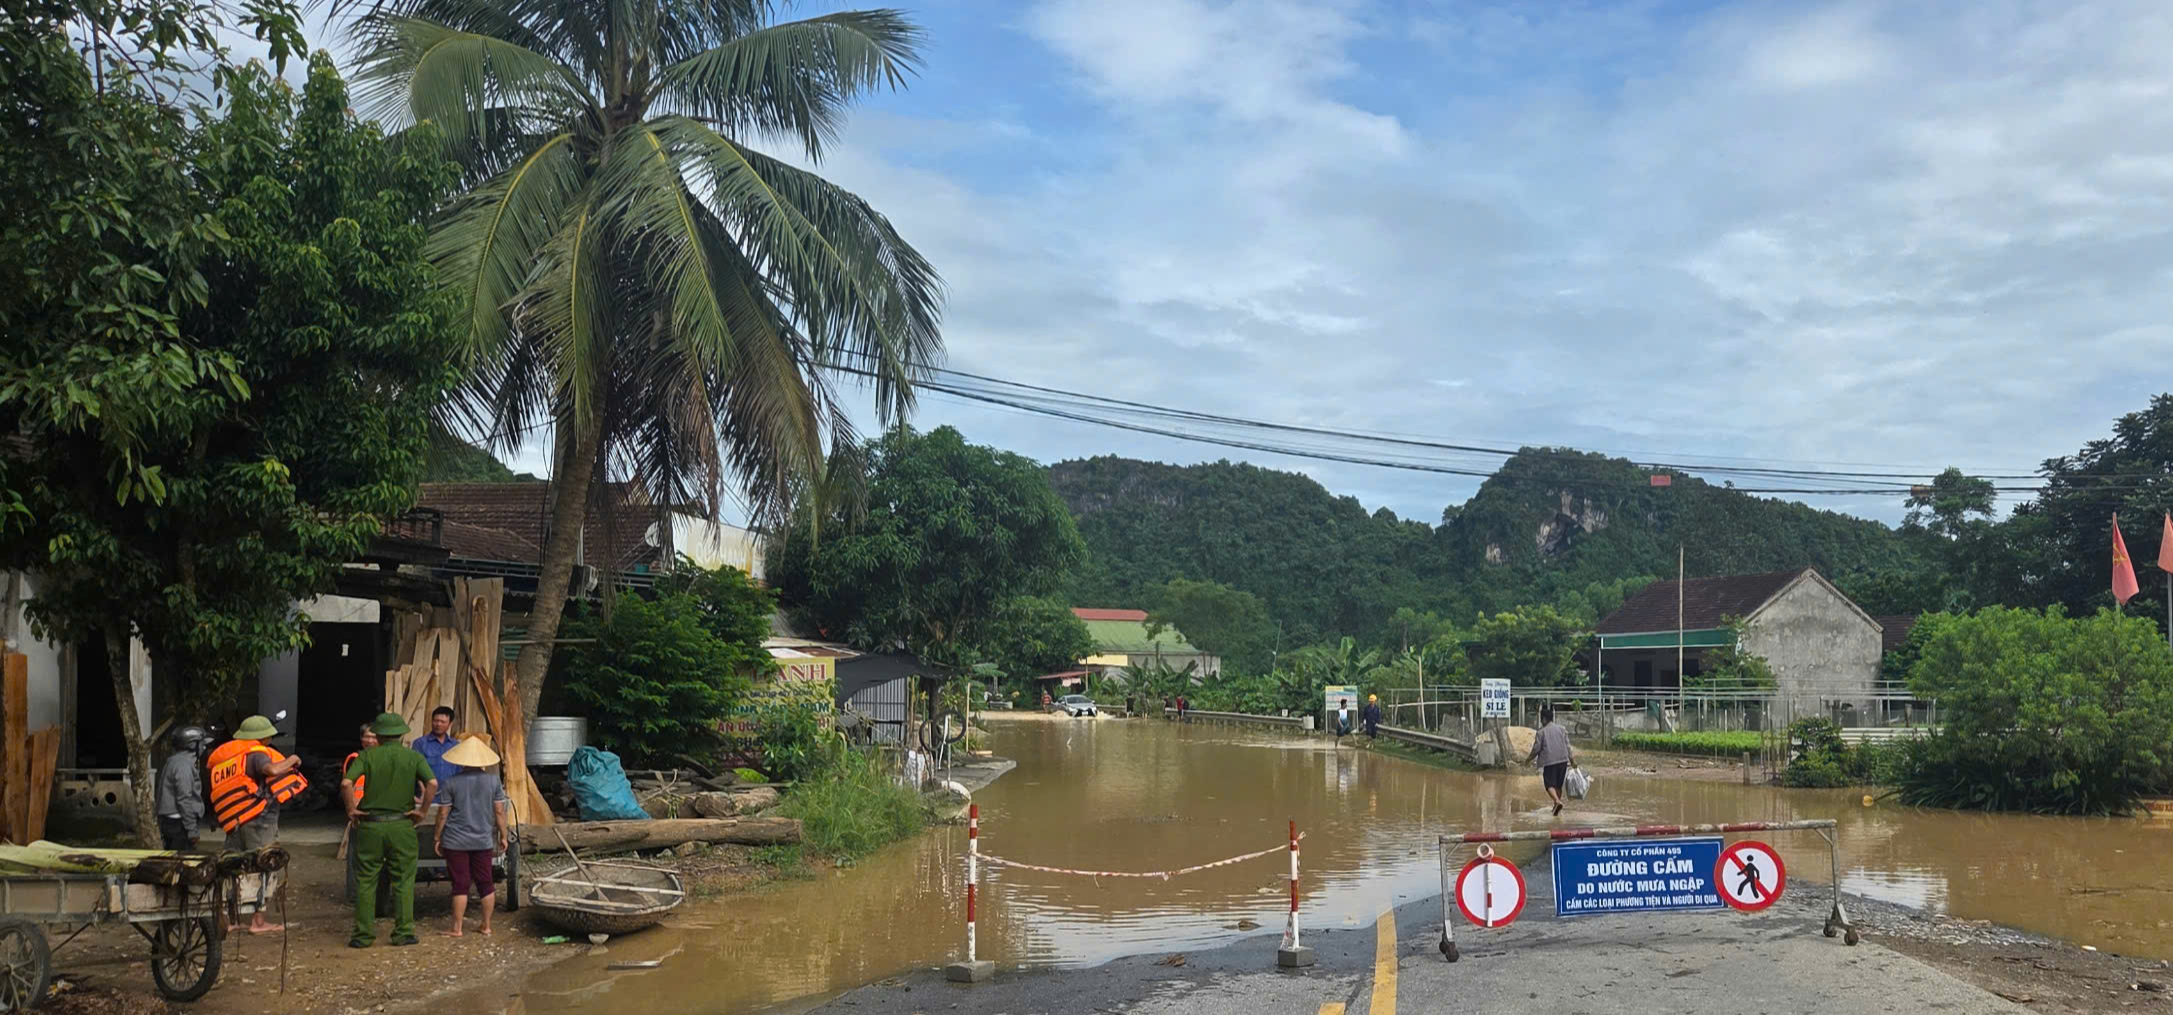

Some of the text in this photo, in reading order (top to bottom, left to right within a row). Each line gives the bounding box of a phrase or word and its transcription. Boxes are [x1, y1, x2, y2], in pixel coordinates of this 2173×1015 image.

[1597, 849, 1618, 857] CÔNG
[1587, 856, 1694, 877] ĐƯỜNG CẤM
[1577, 877, 1705, 894] DO NƯỚC MƯA NGẬP
[1566, 893, 1718, 910] CẤM CÁC LOẠI PHƯƠNG TIỆN VÀ NGƯỜI ĐI QUA
